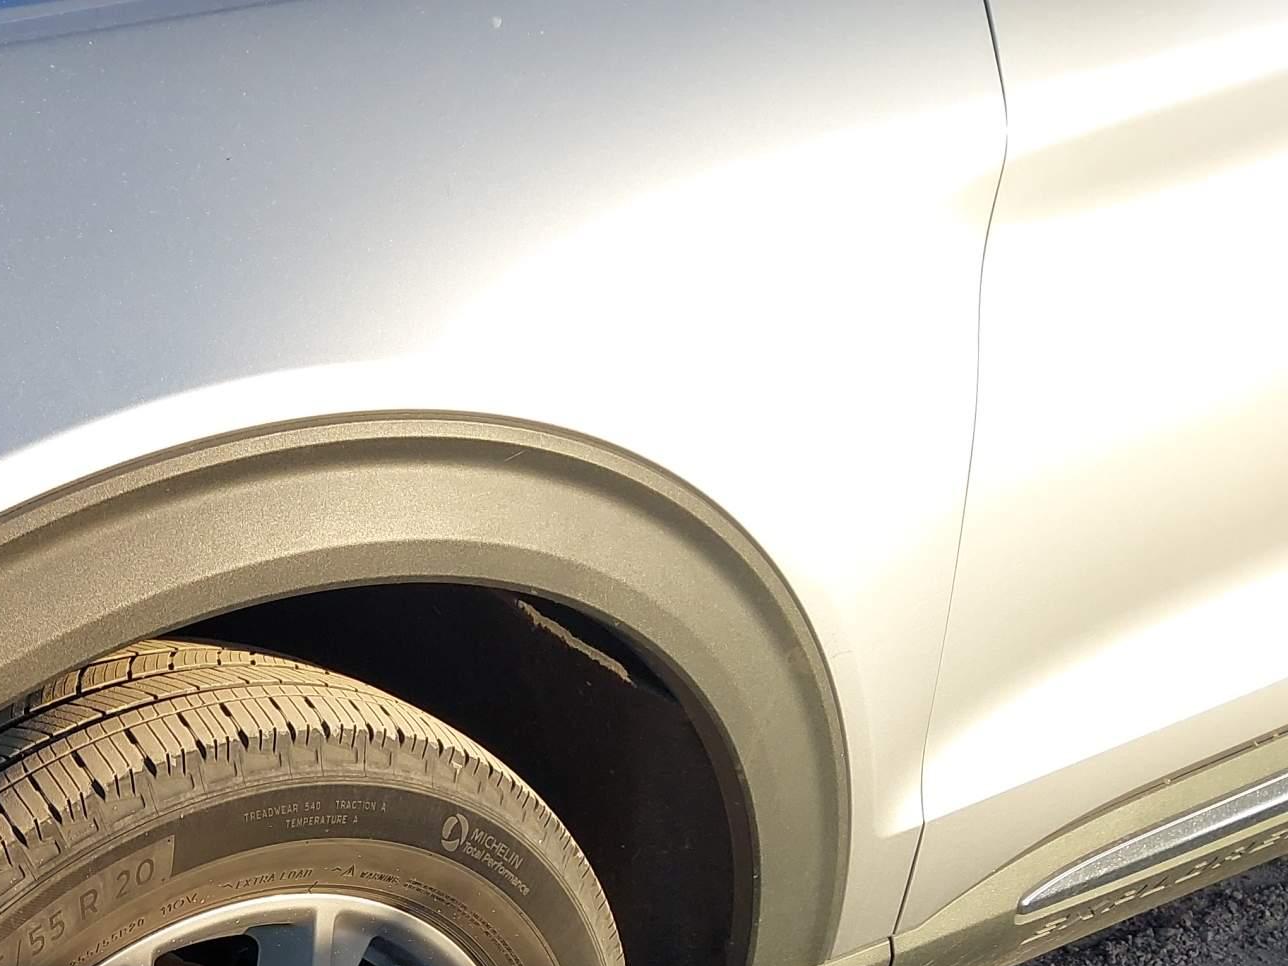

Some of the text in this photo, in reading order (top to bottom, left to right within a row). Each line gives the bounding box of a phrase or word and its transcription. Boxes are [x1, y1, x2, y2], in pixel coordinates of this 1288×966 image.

[243, 803, 299, 823] TREADWEAR
[304, 801, 321, 811] 540
[335, 800, 377, 812] TRACTION
[285, 815, 358, 829] TEMPERATURE A
[463, 841, 530, 896] Total Performance
[470, 828, 524, 869] MICHELIN
[78, 887, 99, 921] R
[115, 858, 155, 900] 20
